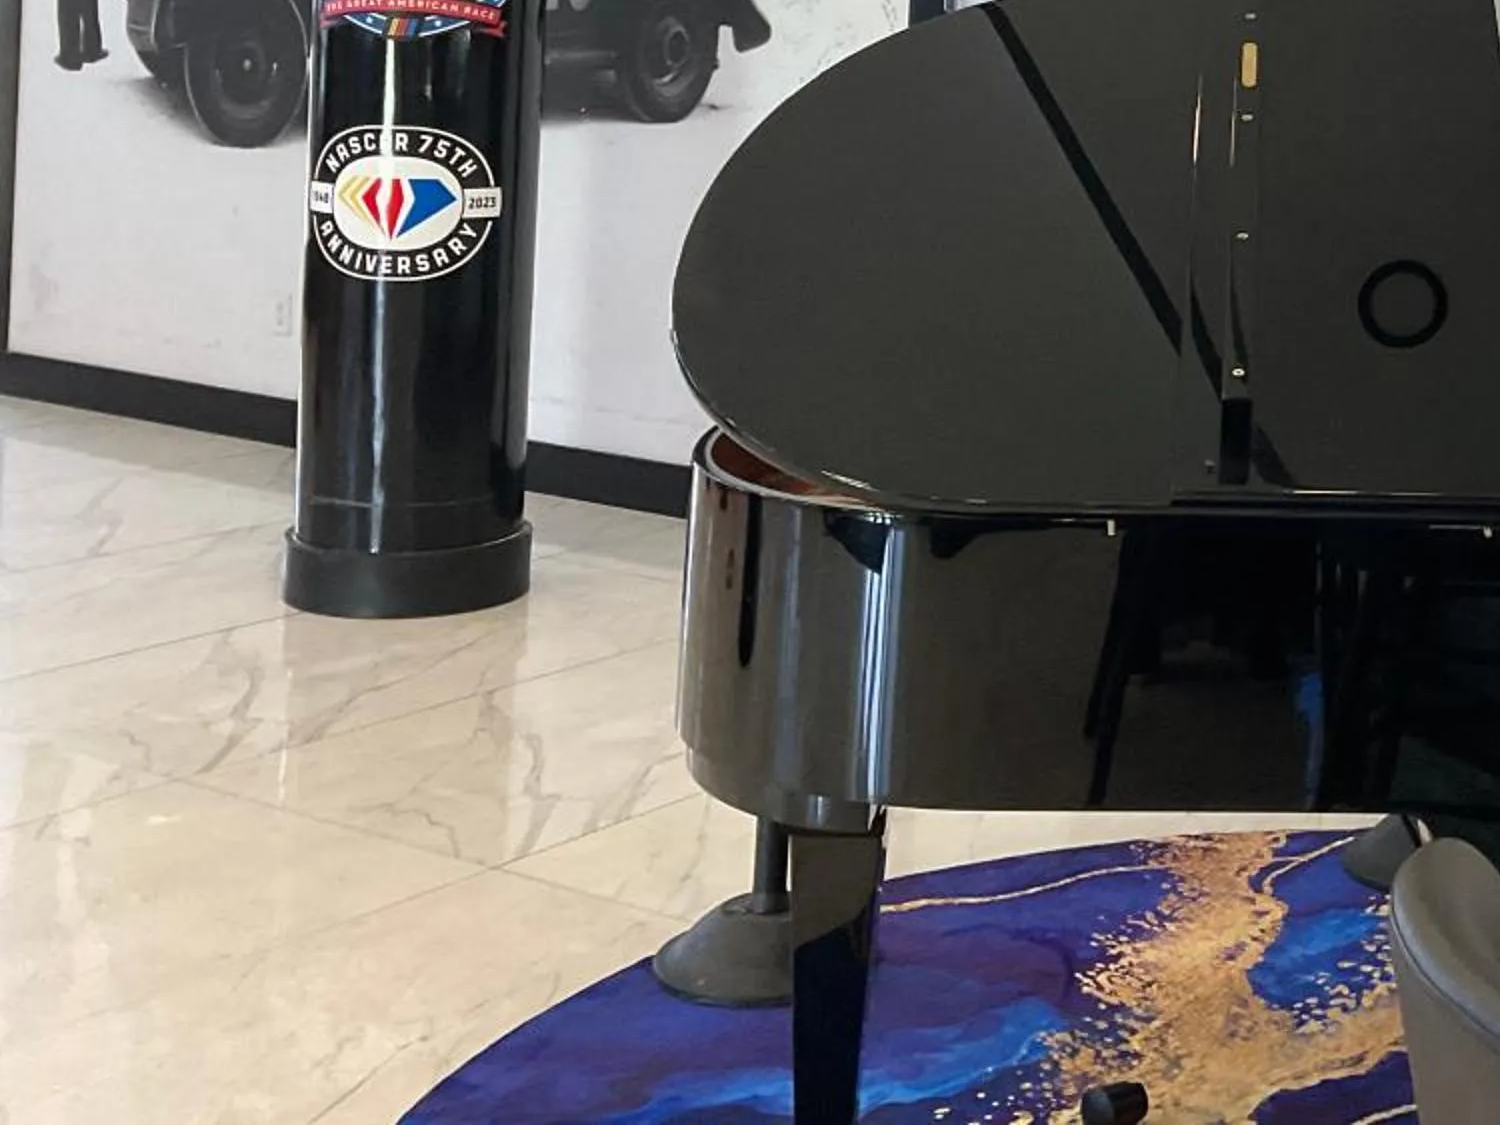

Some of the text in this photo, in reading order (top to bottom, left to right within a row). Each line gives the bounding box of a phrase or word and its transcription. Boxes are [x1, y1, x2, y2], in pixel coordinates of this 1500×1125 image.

[346, 0, 382, 8] GREAT
[464, 6, 495, 19] RACE
[325, 133, 478, 178] NASCR 75TH
[468, 196, 497, 209] 2023
[320, 220, 478, 274] ANNIVERSARY
